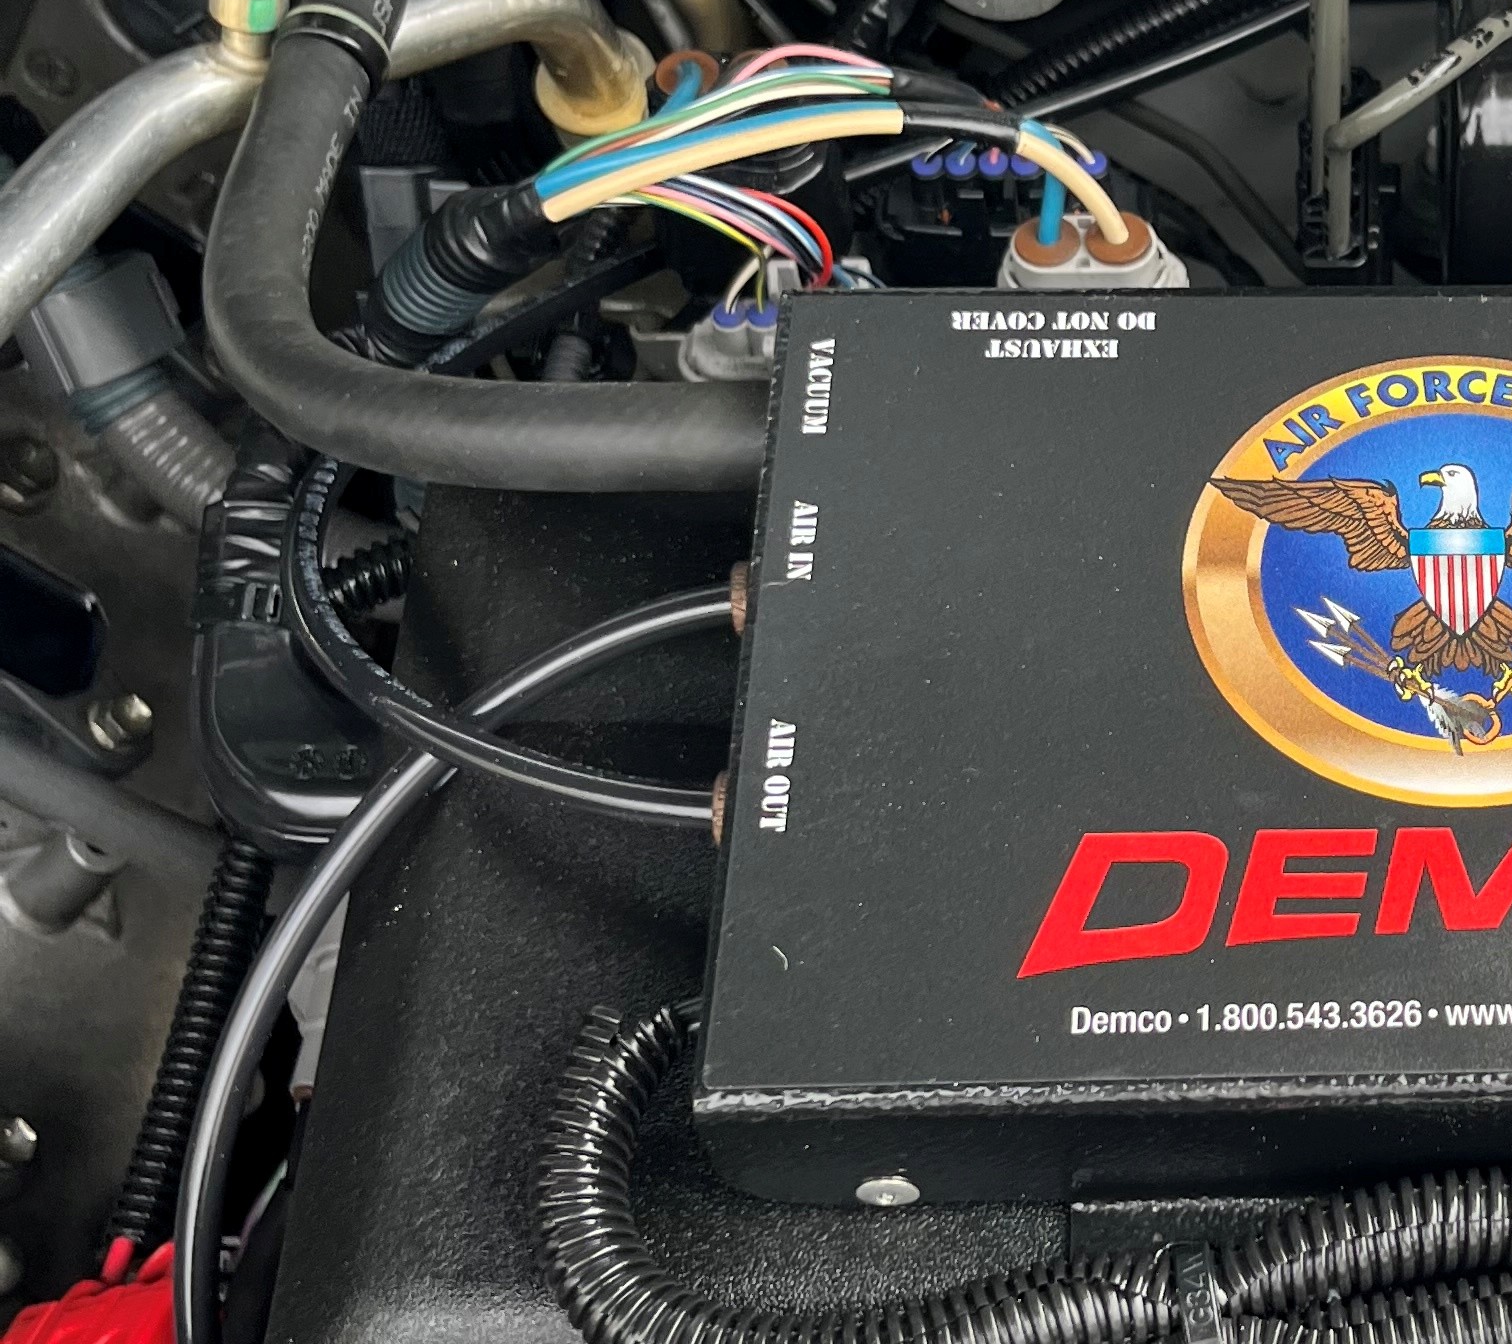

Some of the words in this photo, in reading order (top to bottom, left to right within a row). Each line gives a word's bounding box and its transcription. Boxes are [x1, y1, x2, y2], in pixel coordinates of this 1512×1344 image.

[950, 311, 1046, 331] COVER
[1052, 311, 1111, 331] NOT
[1117, 311, 1157, 331] DO
[985, 339, 1120, 359] EXHAUST
[802, 338, 836, 436] VACUUM
[1264, 403, 1341, 472] AIR
[791, 500, 821, 546] AIR
[786, 553, 816, 583] IN
[765, 718, 797, 769] AIR
[758, 773, 792, 833] OUT
[1069, 1004, 1173, 1035] Demco
[1196, 1000, 1423, 1033] 1.800.543.3626
